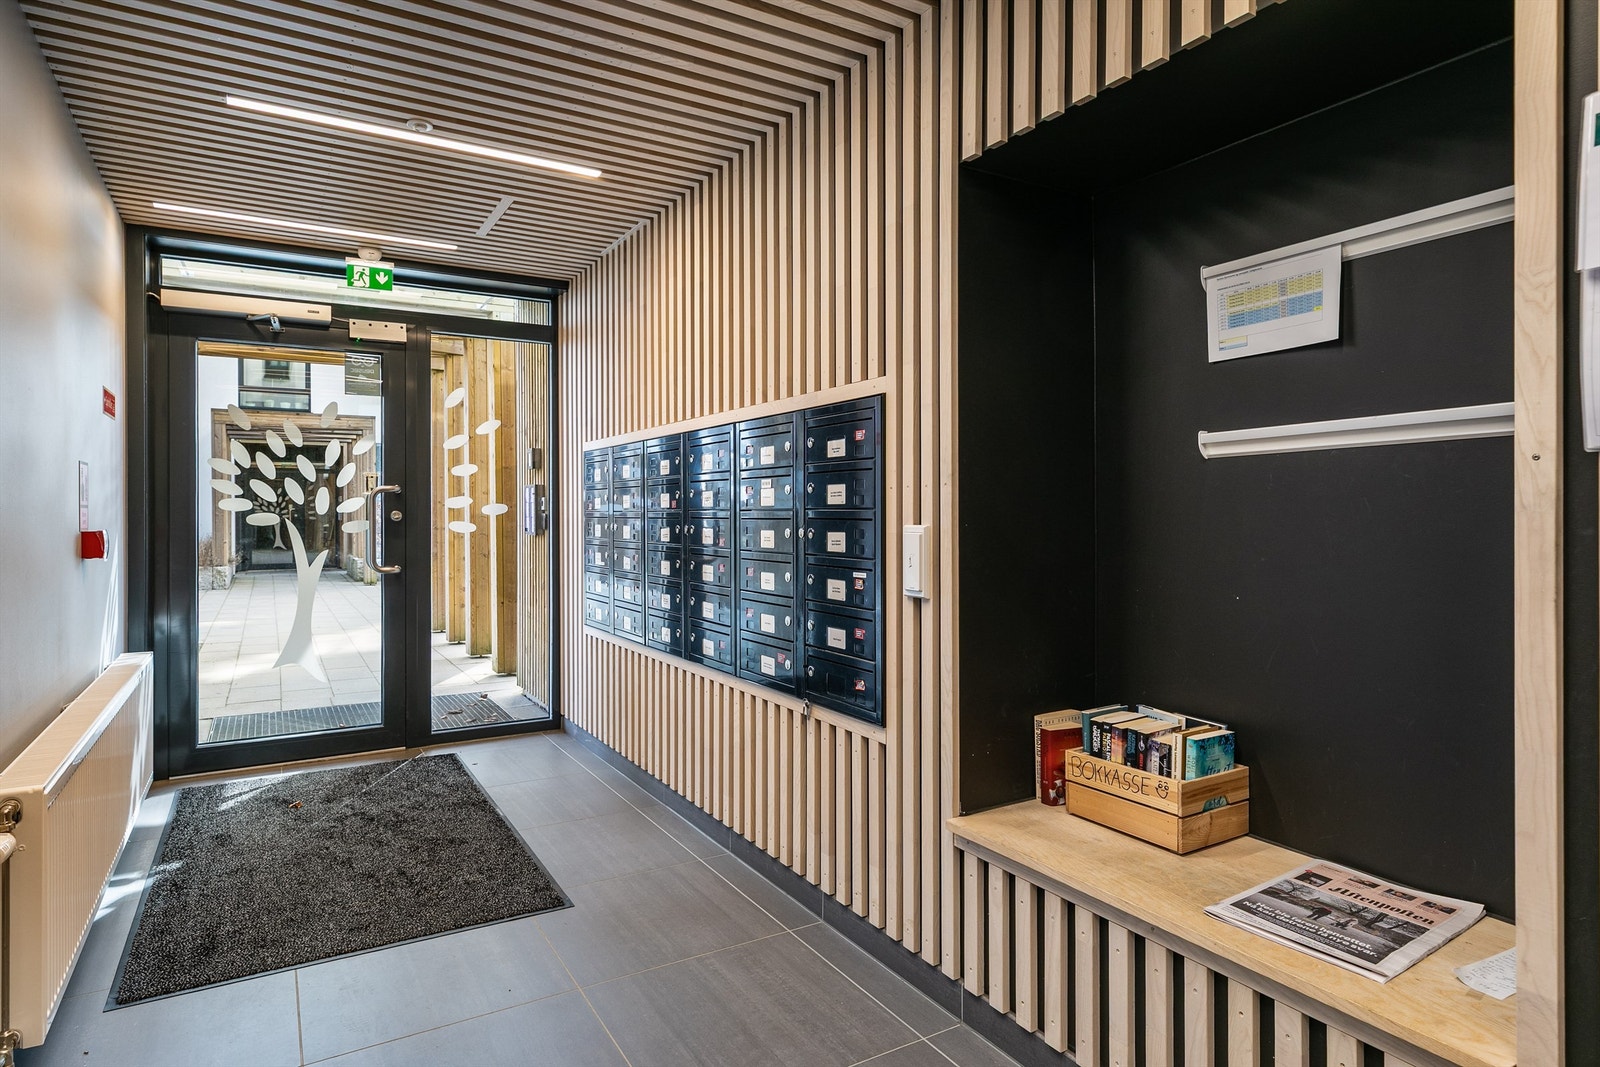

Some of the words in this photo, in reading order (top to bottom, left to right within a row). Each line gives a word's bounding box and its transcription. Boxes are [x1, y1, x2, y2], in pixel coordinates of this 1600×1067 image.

[1070, 755, 1152, 797] BOKKASSE
[1255, 902, 1275, 911] Her
[1291, 917, 1319, 929] faren
[1319, 926, 1373, 950] henrettet.
[1328, 887, 1435, 925] Aftenposten
